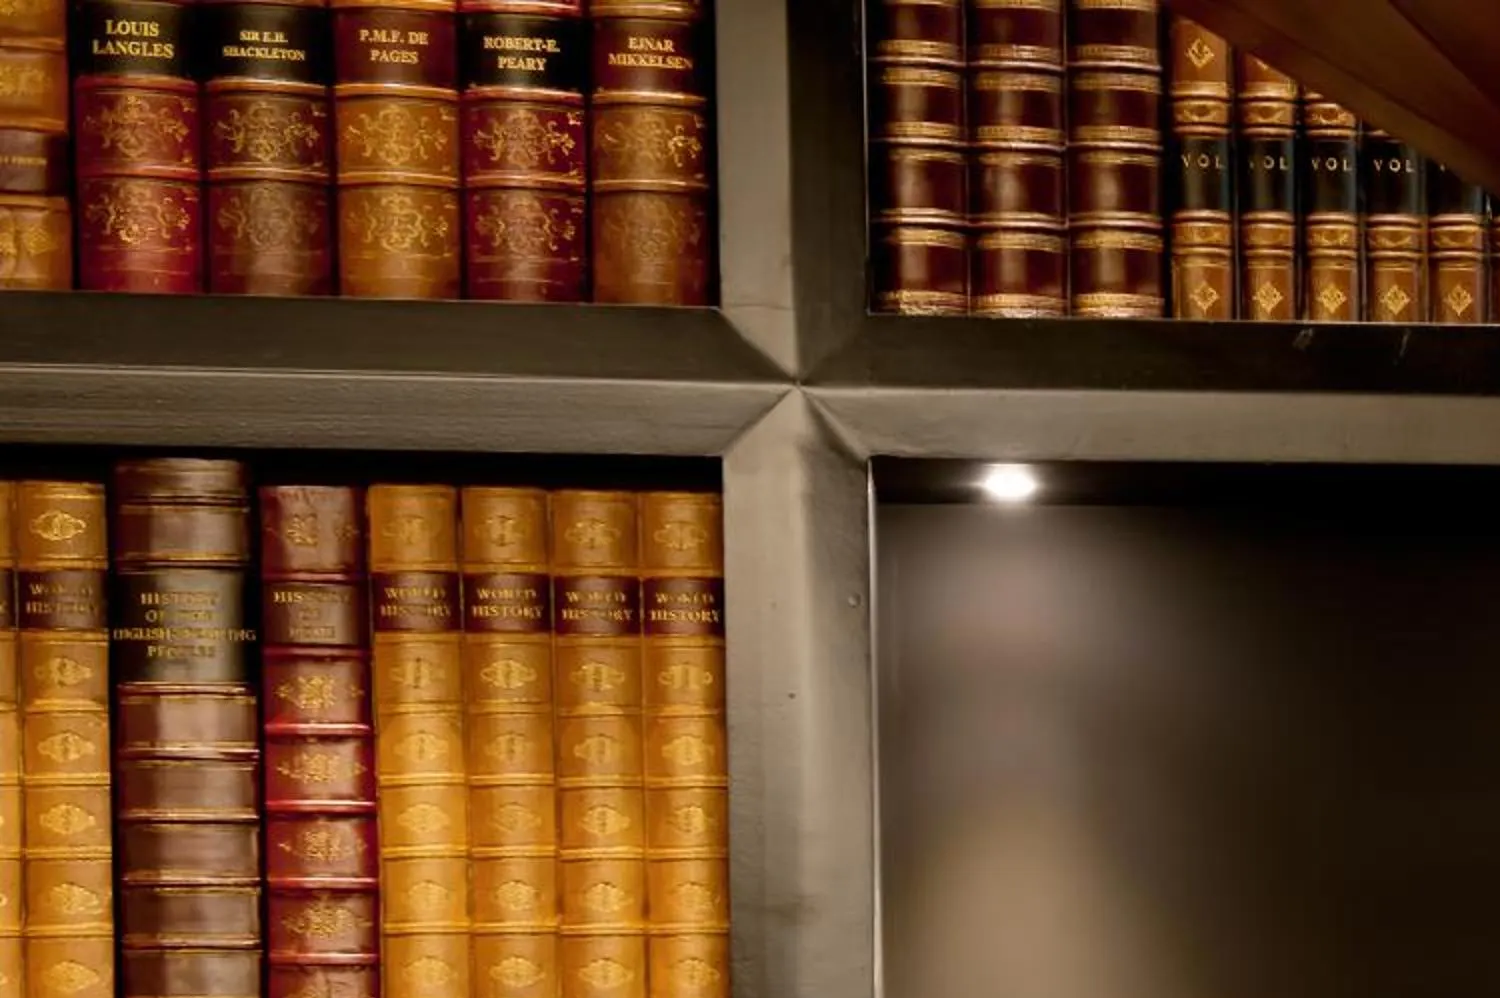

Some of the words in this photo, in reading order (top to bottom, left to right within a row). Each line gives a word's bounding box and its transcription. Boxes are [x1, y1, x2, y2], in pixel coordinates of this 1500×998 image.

[105, 19, 160, 37] LOUIS
[239, 30, 260, 42] SIR
[359, 29, 405, 44] P.M.F.
[408, 31, 429, 46] DE
[92, 39, 174, 59] LANGLES
[222, 45, 306, 61] SHACKLETON
[369, 48, 419, 64] PAGES
[497, 55, 547, 71] PEARY
[607, 53, 693, 69] MIKKELSEN
[1181, 153, 1226, 169] VOL
[1311, 156, 1352, 173] VOL
[1373, 158, 1416, 173] VOL
[565, 590, 627, 604] WRLD
[380, 604, 451, 618] HISRY
[472, 604, 544, 620] HISTORY
[561, 608, 632, 622] HISTRY
[651, 608, 721, 624] HISTORY
